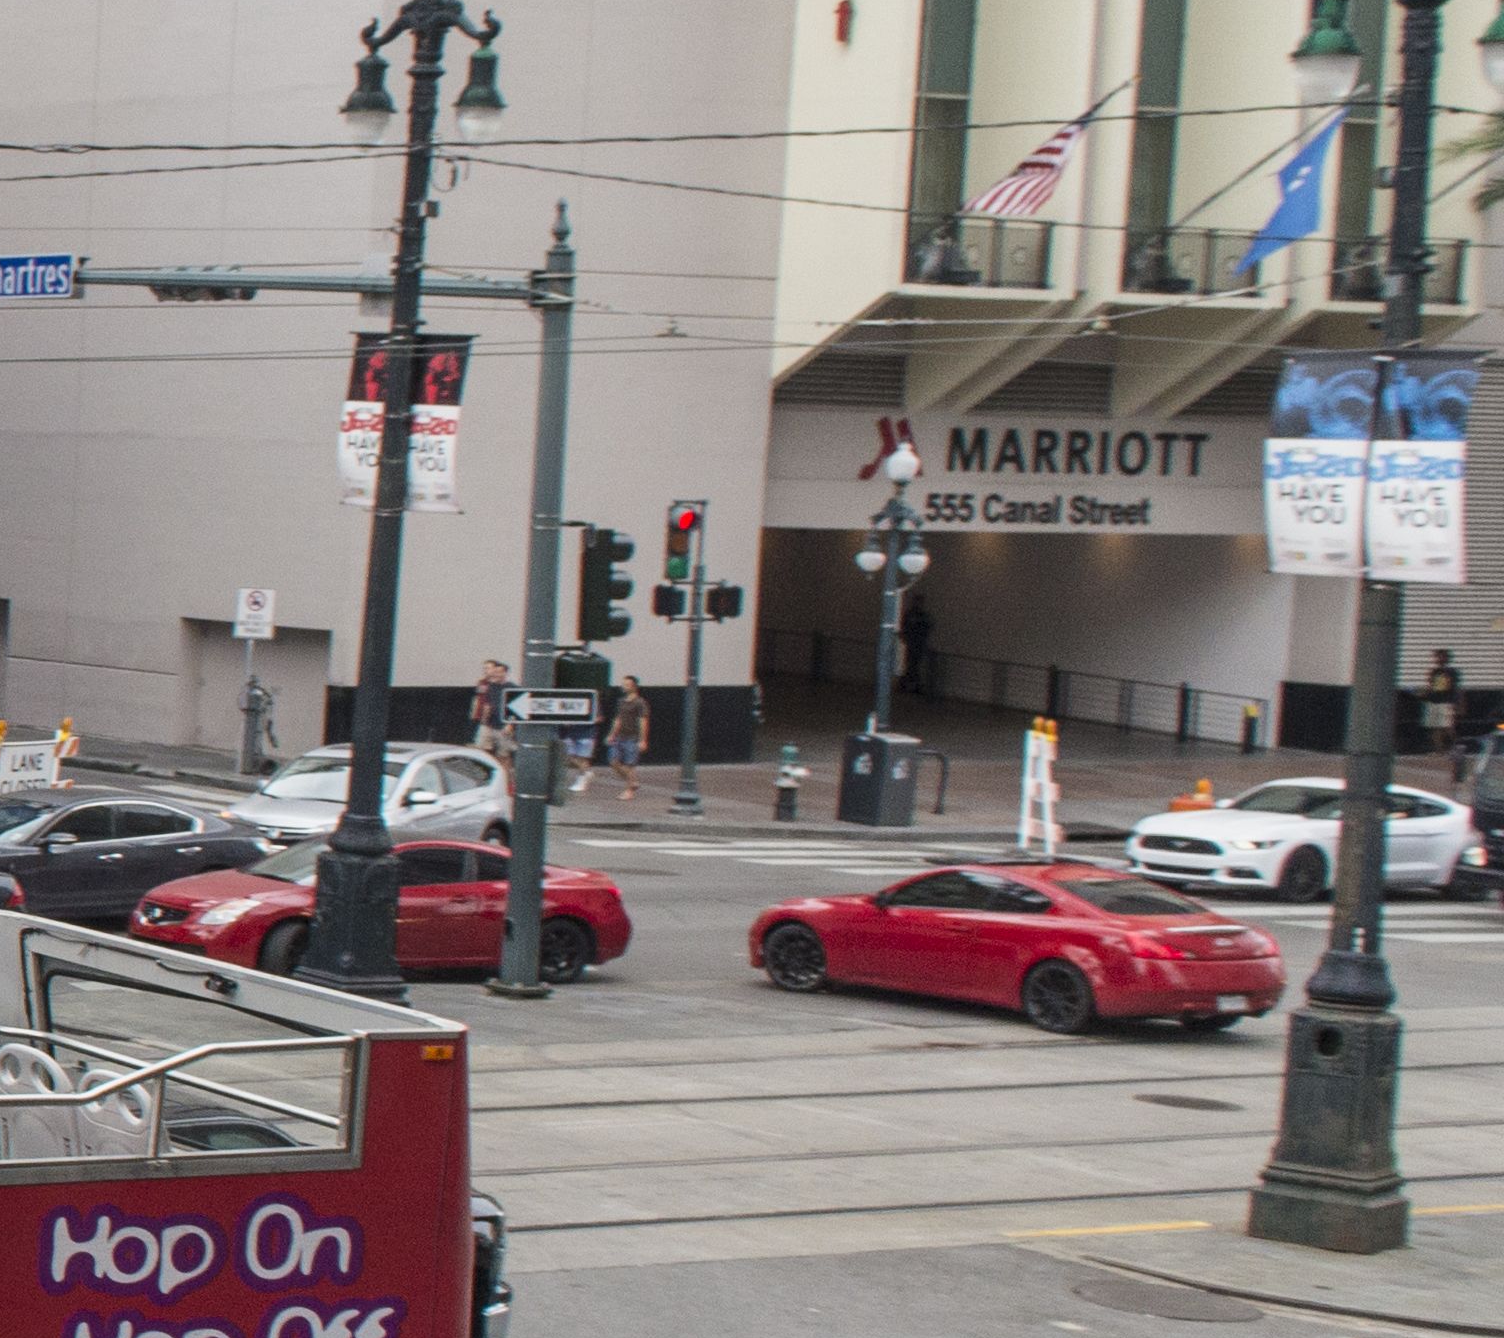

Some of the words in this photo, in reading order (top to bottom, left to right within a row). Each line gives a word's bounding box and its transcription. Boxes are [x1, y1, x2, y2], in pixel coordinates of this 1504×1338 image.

[946, 427, 1211, 477] MARRIOTT
[1278, 484, 1344, 503] HAVE
[1378, 487, 1445, 506] HAVE
[925, 493, 976, 523] 555
[983, 494, 1063, 524] Canal
[1069, 495, 1152, 525] Street
[1294, 505, 1346, 524] YOU
[1394, 509, 1449, 528] YOU
[11, 752, 45, 773] LANE
[49, 1212, 215, 1295] Hop
[243, 1202, 352, 1283] On
